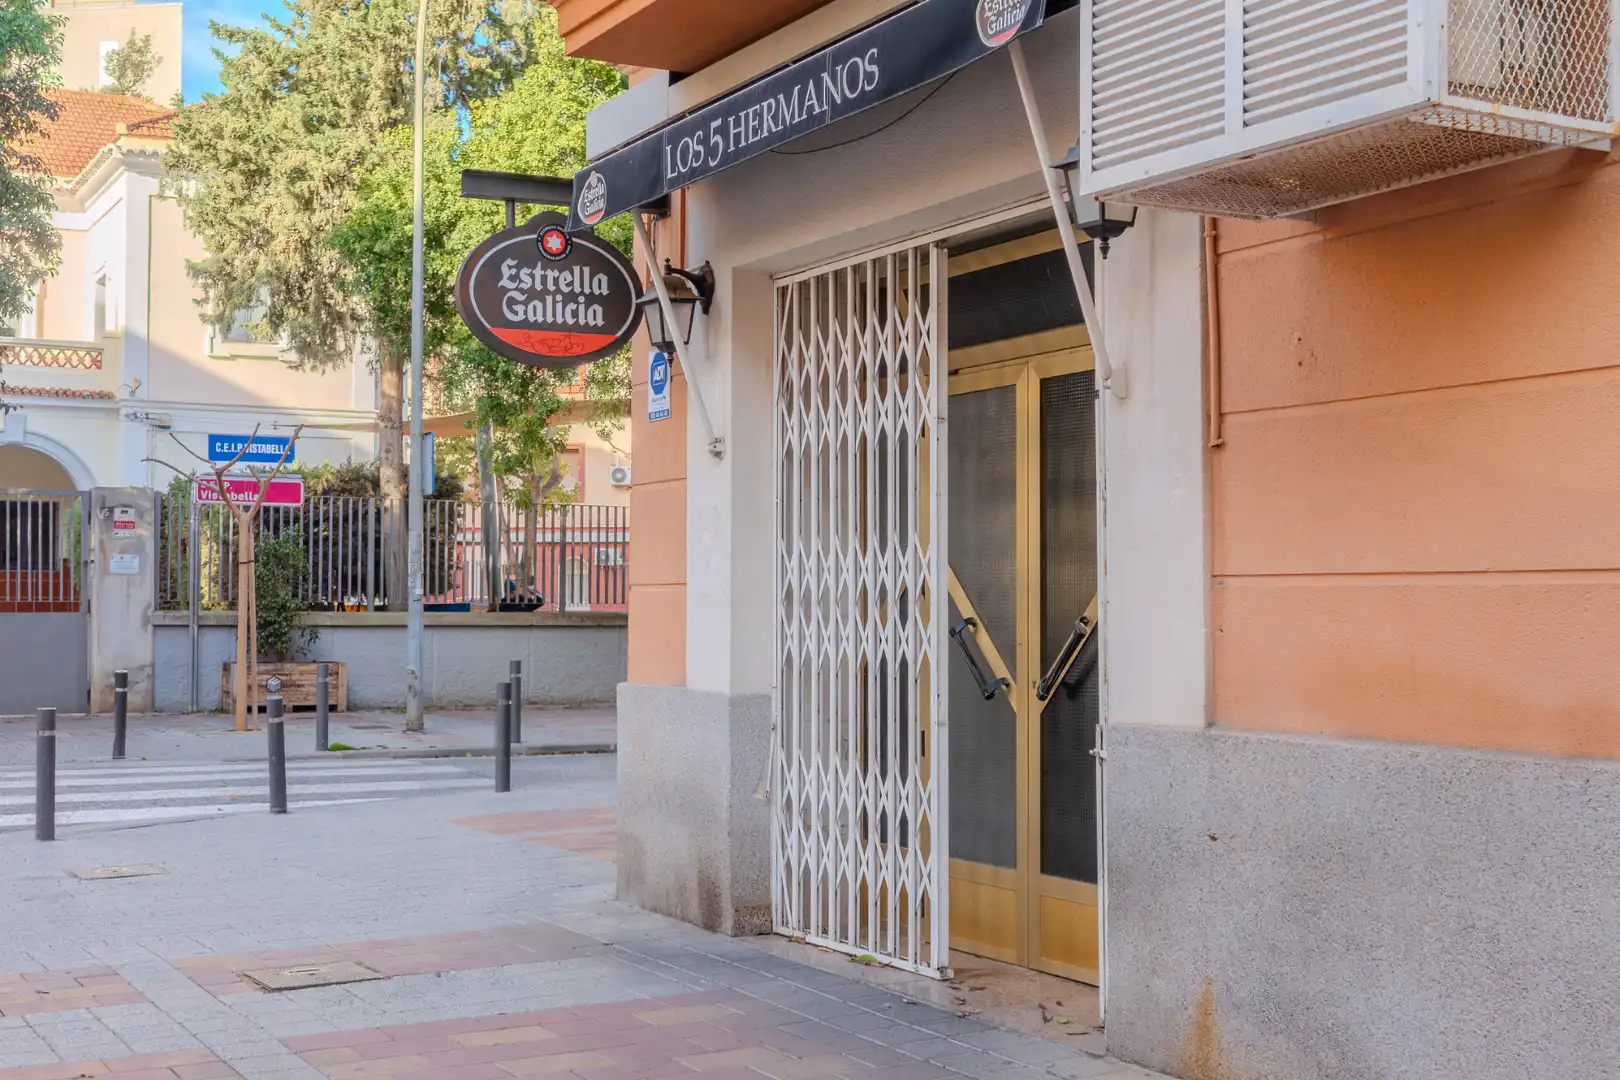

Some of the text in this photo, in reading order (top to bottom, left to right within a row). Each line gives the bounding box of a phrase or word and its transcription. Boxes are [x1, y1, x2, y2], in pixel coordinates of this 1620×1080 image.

[987, 3, 1025, 35] Galicia
[666, 48, 879, 179] LOS 5 HERMANOS
[498, 257, 611, 297] Estrella
[502, 290, 605, 328] Galicia
